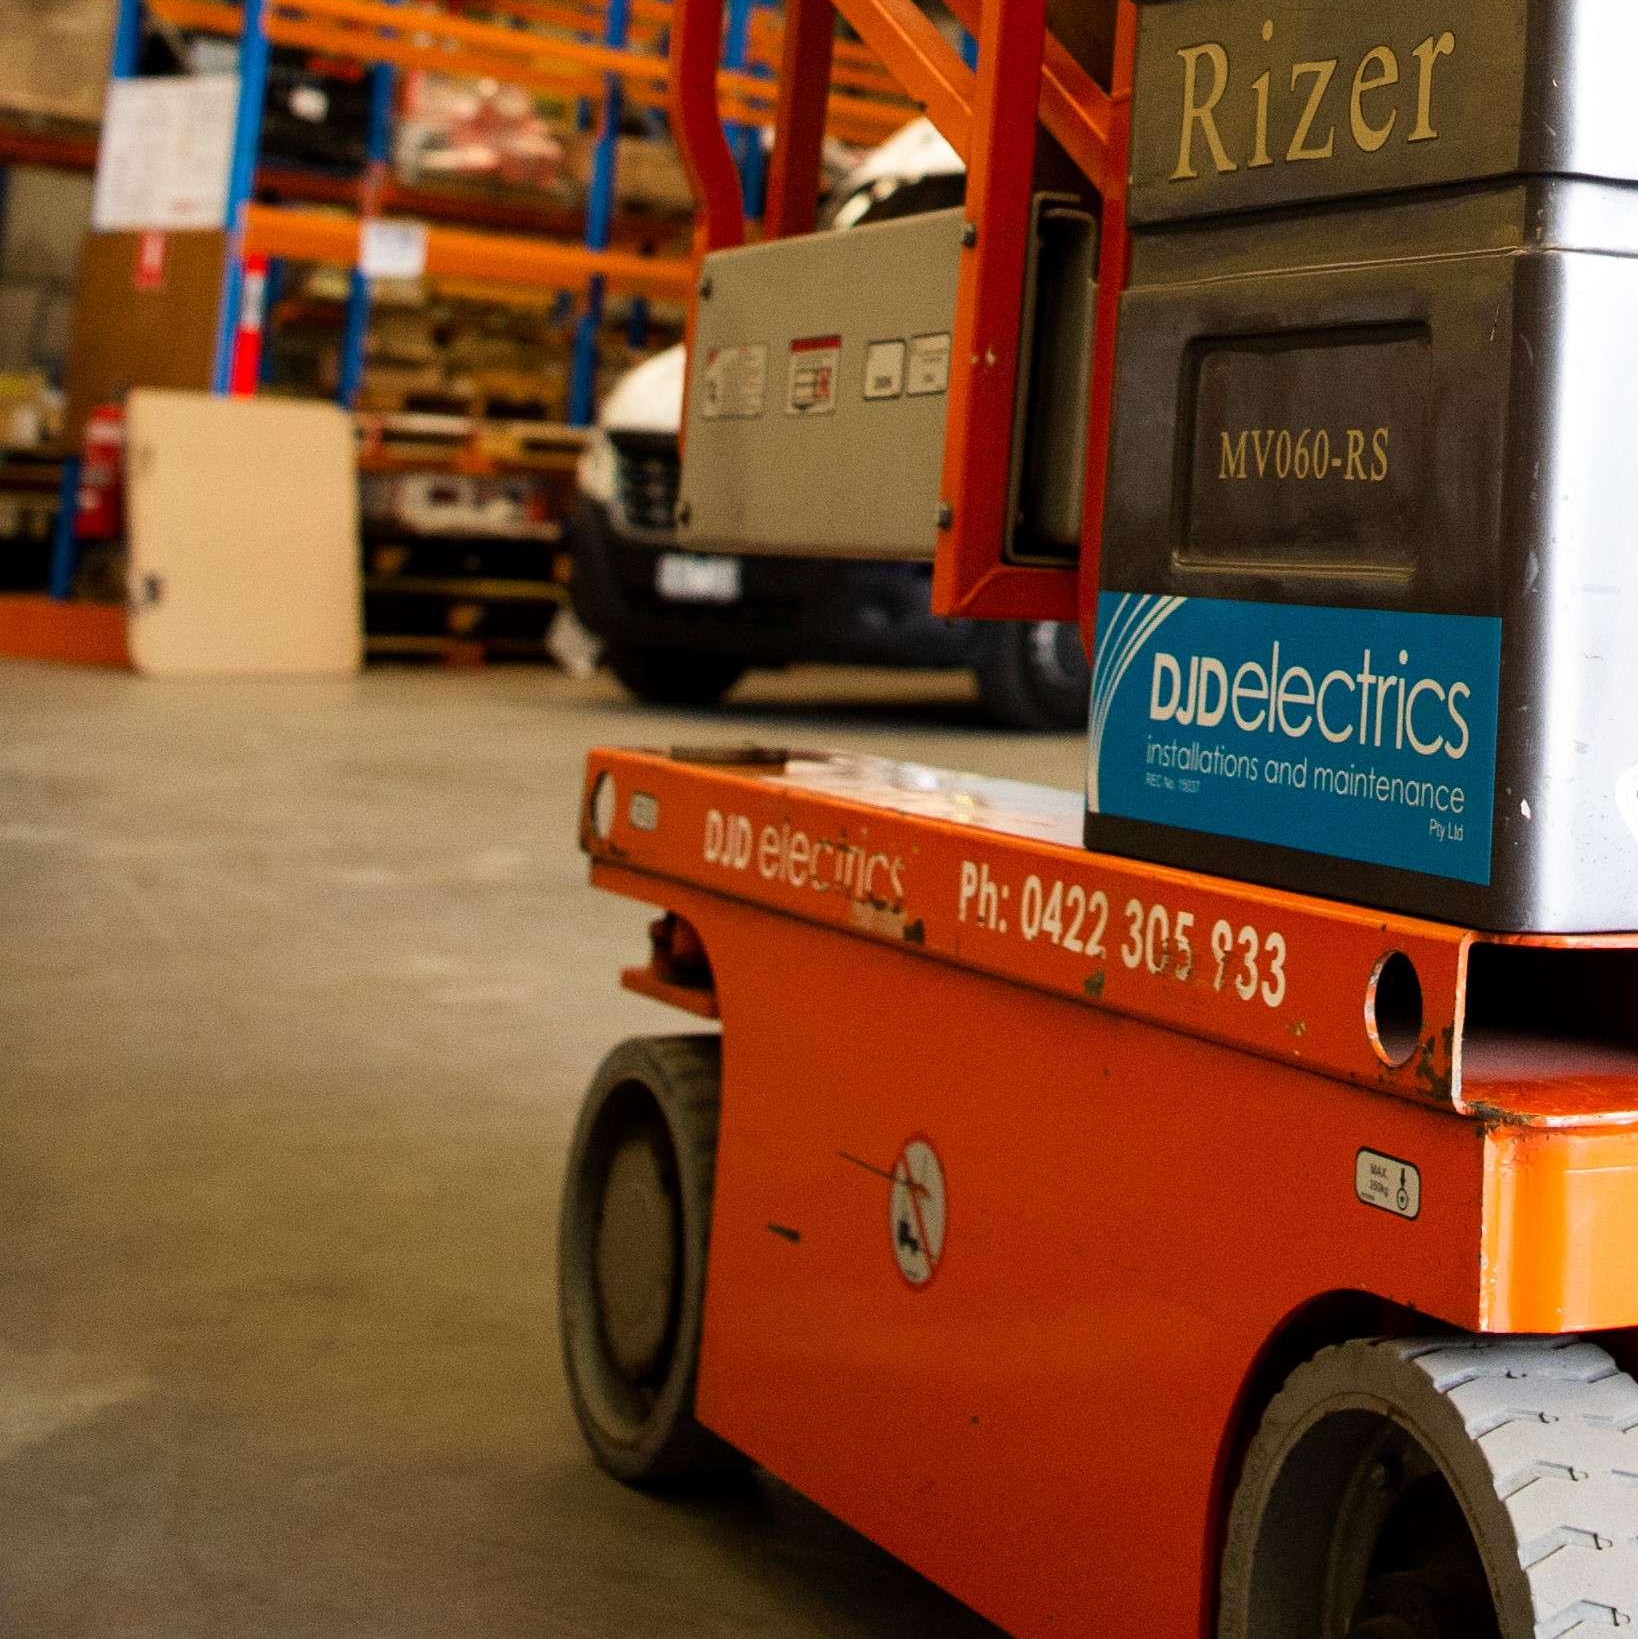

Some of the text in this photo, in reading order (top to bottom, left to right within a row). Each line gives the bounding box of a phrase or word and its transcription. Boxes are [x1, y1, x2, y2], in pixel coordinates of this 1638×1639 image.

[1168, 18, 1456, 181] Rizer
[1217, 425, 1390, 482] MV060-RS
[1146, 734, 1465, 814] installations and maintenance
[1429, 818, 1464, 842] Pty Ltd
[702, 808, 1288, 1009] DJD electrics Ph: 0422 305 933
